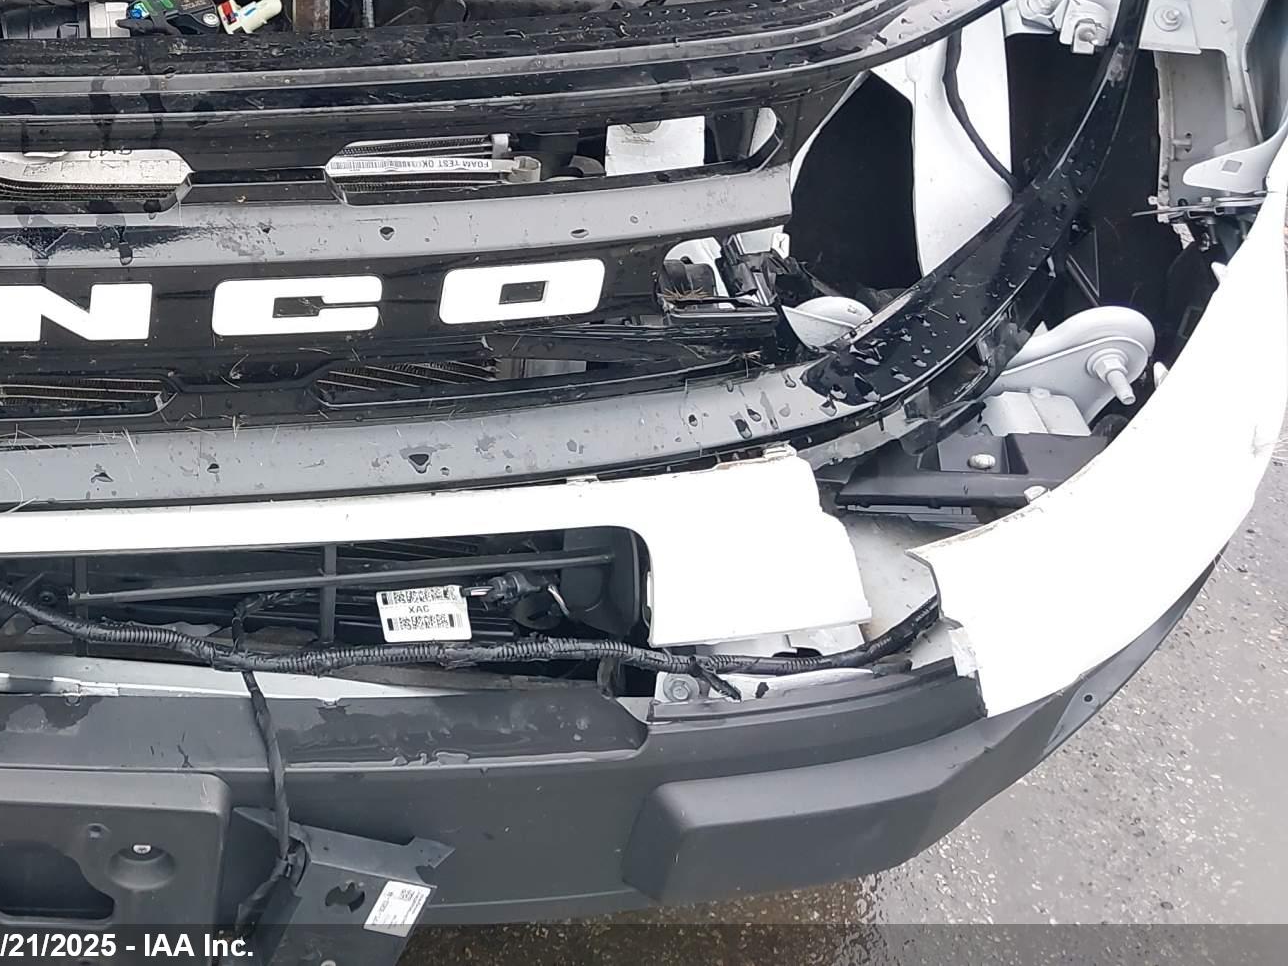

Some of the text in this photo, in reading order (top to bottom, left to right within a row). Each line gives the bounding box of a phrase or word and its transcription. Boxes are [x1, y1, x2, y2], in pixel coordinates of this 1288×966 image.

[421, 158, 490, 168] FOAM TEST OK
